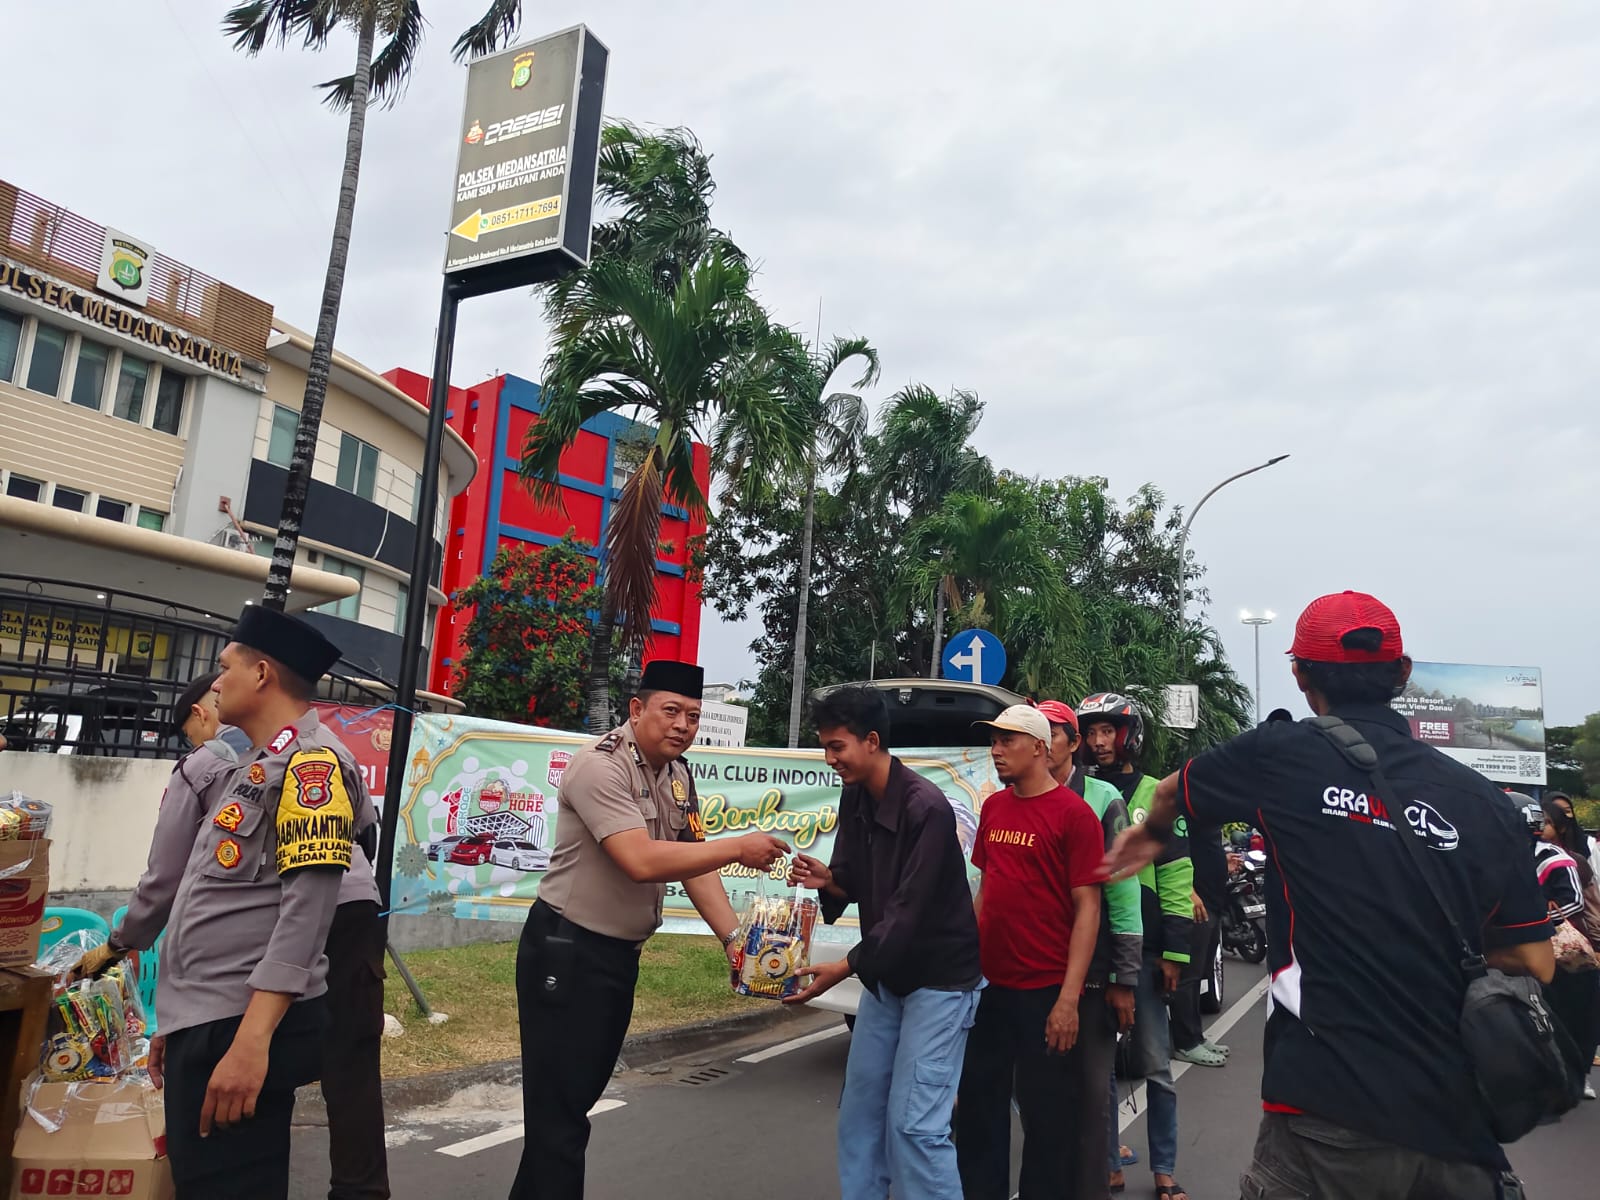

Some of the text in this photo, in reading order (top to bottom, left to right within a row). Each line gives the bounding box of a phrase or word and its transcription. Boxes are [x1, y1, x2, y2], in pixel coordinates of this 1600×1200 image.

[486, 103, 565, 140] PRESISI
[458, 145, 567, 188] POLSEK MEDANSATRIA
[456, 165, 564, 202] KAMI SIAP MELAYANI ANDA
[491, 200, 558, 226] 0851-1711-7694
[82, 295, 163, 346] MEDAN
[168, 330, 242, 378] SATRIA
[1419, 696, 1444, 704] Resort
[1419, 721, 1449, 731] FREE
[724, 765, 768, 783] CLUB
[772, 768, 846, 788] INDONE
[232, 784, 264, 803] POLRI
[509, 792, 544, 801] BISA BISA
[508, 799, 544, 813] HORE
[1322, 807, 1348, 817] GRAND
[700, 788, 837, 849] Berbagi
[989, 829, 1036, 847] HUMBLE
[289, 851, 327, 865] MEDAN
